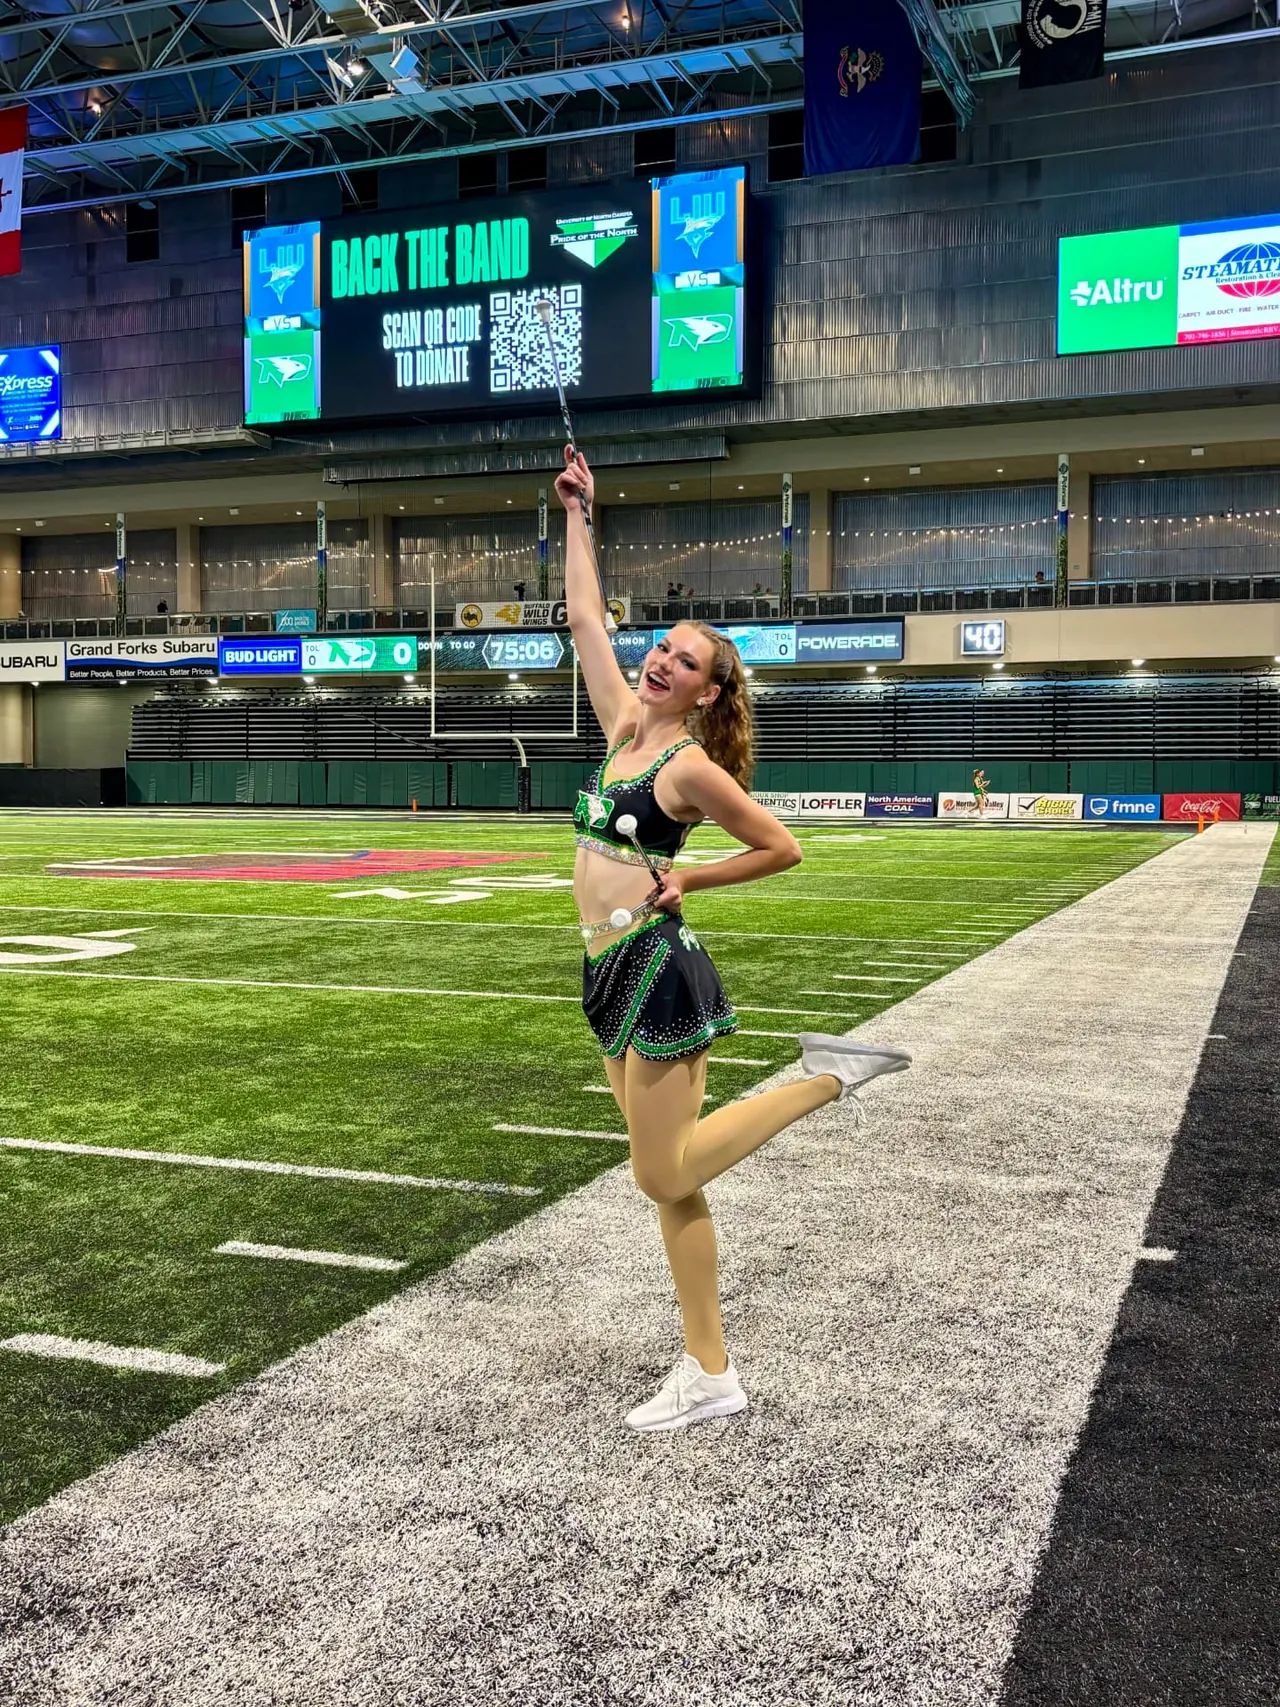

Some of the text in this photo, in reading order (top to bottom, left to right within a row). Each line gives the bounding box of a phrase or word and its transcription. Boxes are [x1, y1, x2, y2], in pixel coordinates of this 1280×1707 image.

[331, 217, 529, 298] BACK THE BAND
[1265, 270, 1280, 279] Clea
[1089, 277, 1164, 306] Altru
[382, 304, 482, 351] SCAN QR CODE
[395, 346, 469, 388] TO DONATE
[523, 608, 549, 619] WILD
[522, 618, 548, 626] WINGS
[965, 623, 1000, 651] 40
[70, 640, 216, 657] Grand Forks Subaru
[449, 641, 462, 650] TO
[463, 640, 476, 649] GO
[490, 639, 555, 662] 75:06
[225, 649, 297, 664] BUD LIGHT
[393, 642, 412, 665] 0
[0, 656, 58, 669] UBARU
[69, 670, 89, 678] Better
[116, 669, 136, 677] Better
[170, 668, 190, 676] Better
[752, 798, 797, 809] HENTICS
[801, 798, 863, 810] LOFFLER
[868, 795, 932, 803] North American
[1036, 798, 1077, 809] RIGHT
[884, 804, 914, 812] COAL
[1112, 800, 1156, 814] fmne
[1180, 799, 1223, 814] Coca-Col
